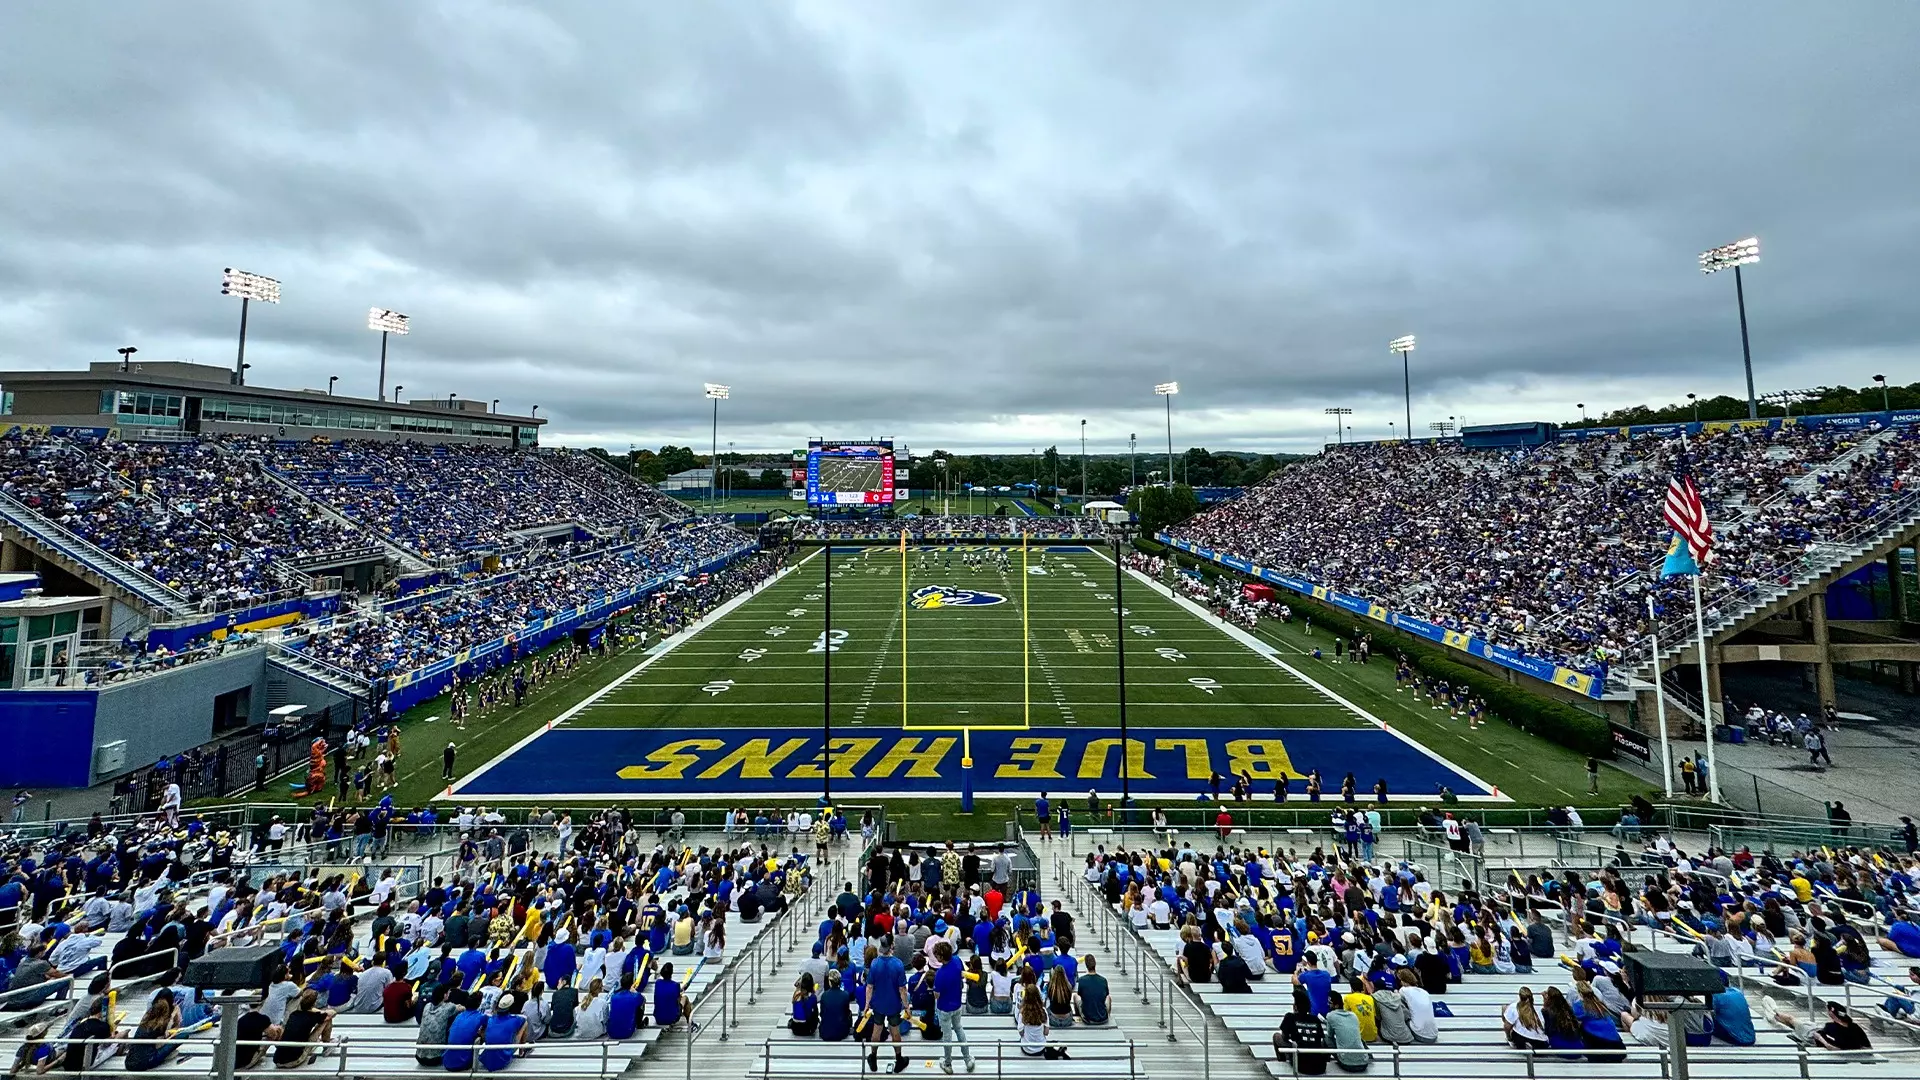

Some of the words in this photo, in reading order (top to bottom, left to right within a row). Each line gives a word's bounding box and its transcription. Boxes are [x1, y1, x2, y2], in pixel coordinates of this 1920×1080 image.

[738, 648, 768, 660] 20
[1154, 647, 1187, 660] 20
[1507, 656, 1526, 668] LOCAL
[1525, 663, 1539, 672] 313
[701, 679, 735, 693] 10
[1187, 677, 1223, 690] 10
[615, 737, 957, 779] HENS
[993, 738, 1299, 780] BLUE
